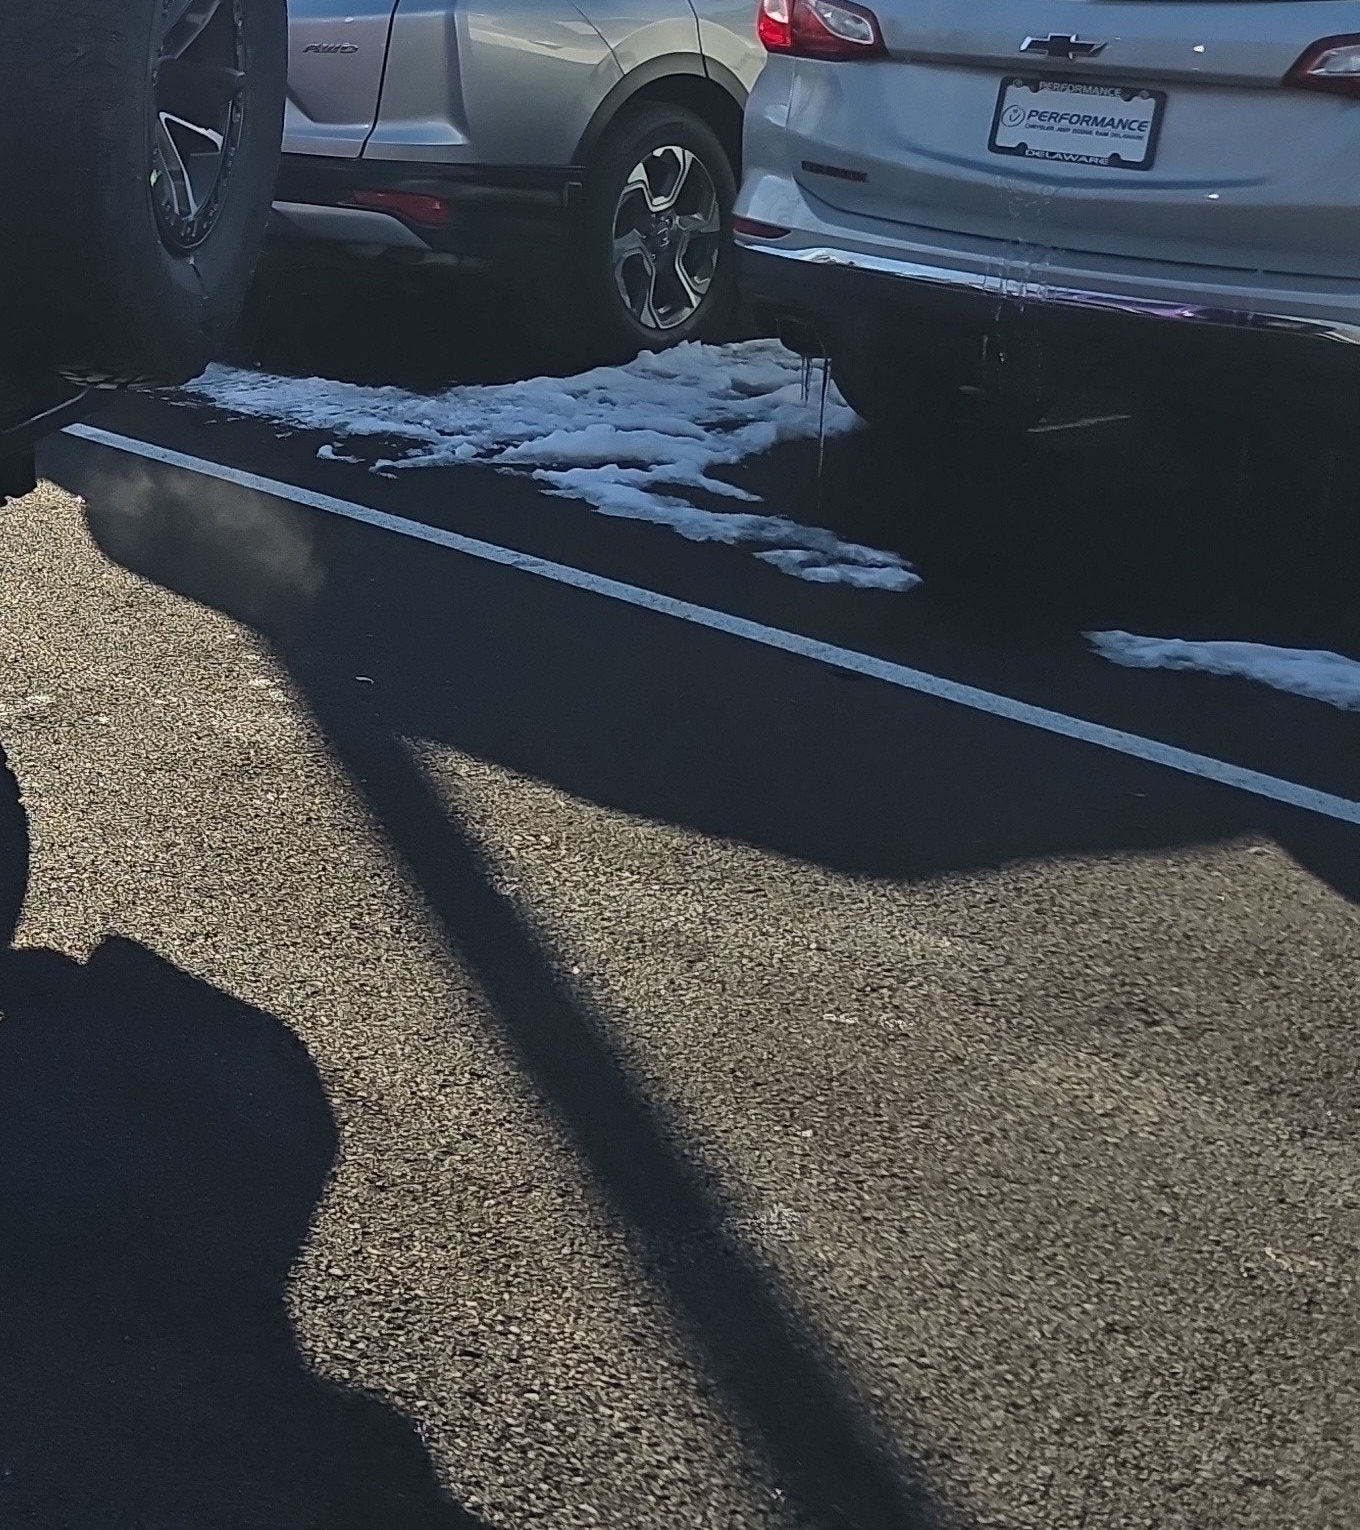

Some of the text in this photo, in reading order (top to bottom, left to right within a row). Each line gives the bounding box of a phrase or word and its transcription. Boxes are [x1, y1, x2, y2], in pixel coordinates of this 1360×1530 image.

[302, 43, 359, 54] AWD
[1039, 80, 1122, 97] PERFORMANCE
[1026, 109, 1150, 133] PERFORMANCE
[1025, 148, 1110, 166] DELAWARE
